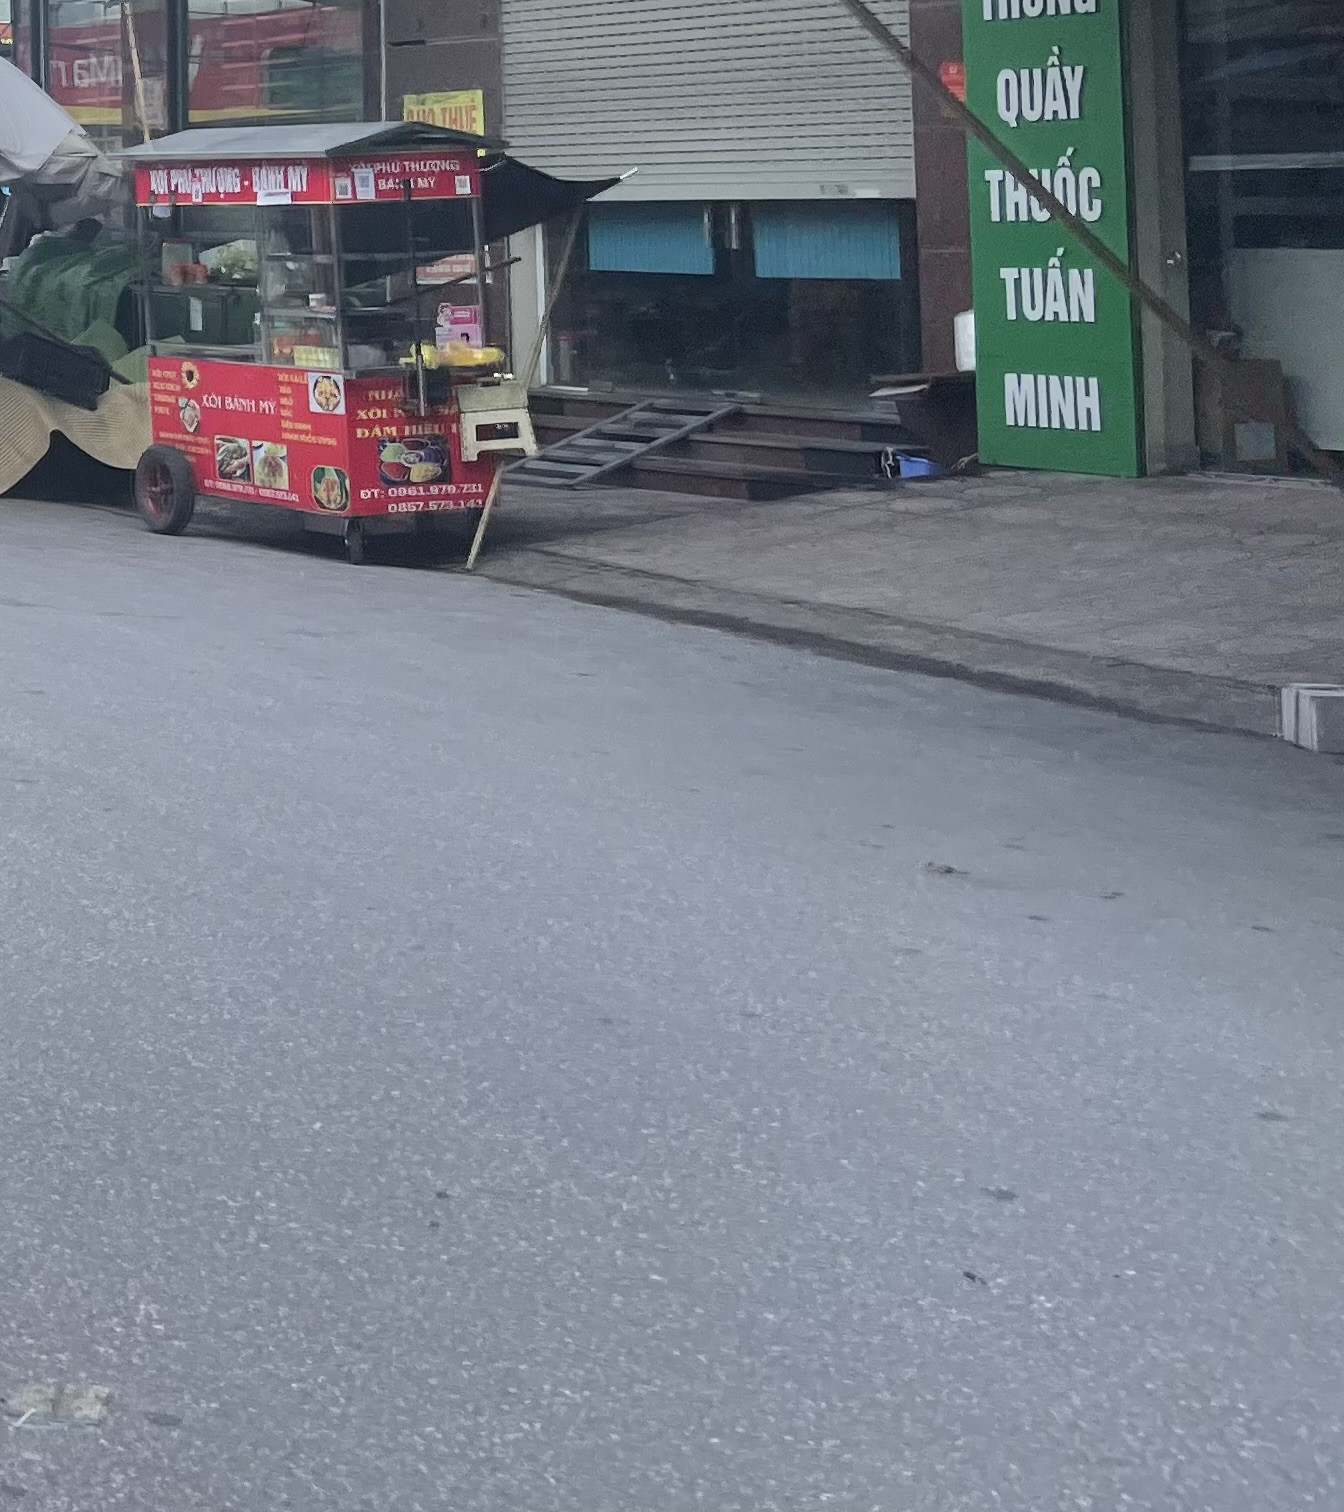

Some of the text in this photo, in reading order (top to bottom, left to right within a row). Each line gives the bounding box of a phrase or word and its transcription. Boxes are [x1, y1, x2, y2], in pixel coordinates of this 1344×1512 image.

[997, 45, 1084, 128] QUẦY
[984, 146, 1102, 223] THUỐC
[1000, 247, 1095, 322] TUẤN
[1004, 373, 1101, 431] MINH
